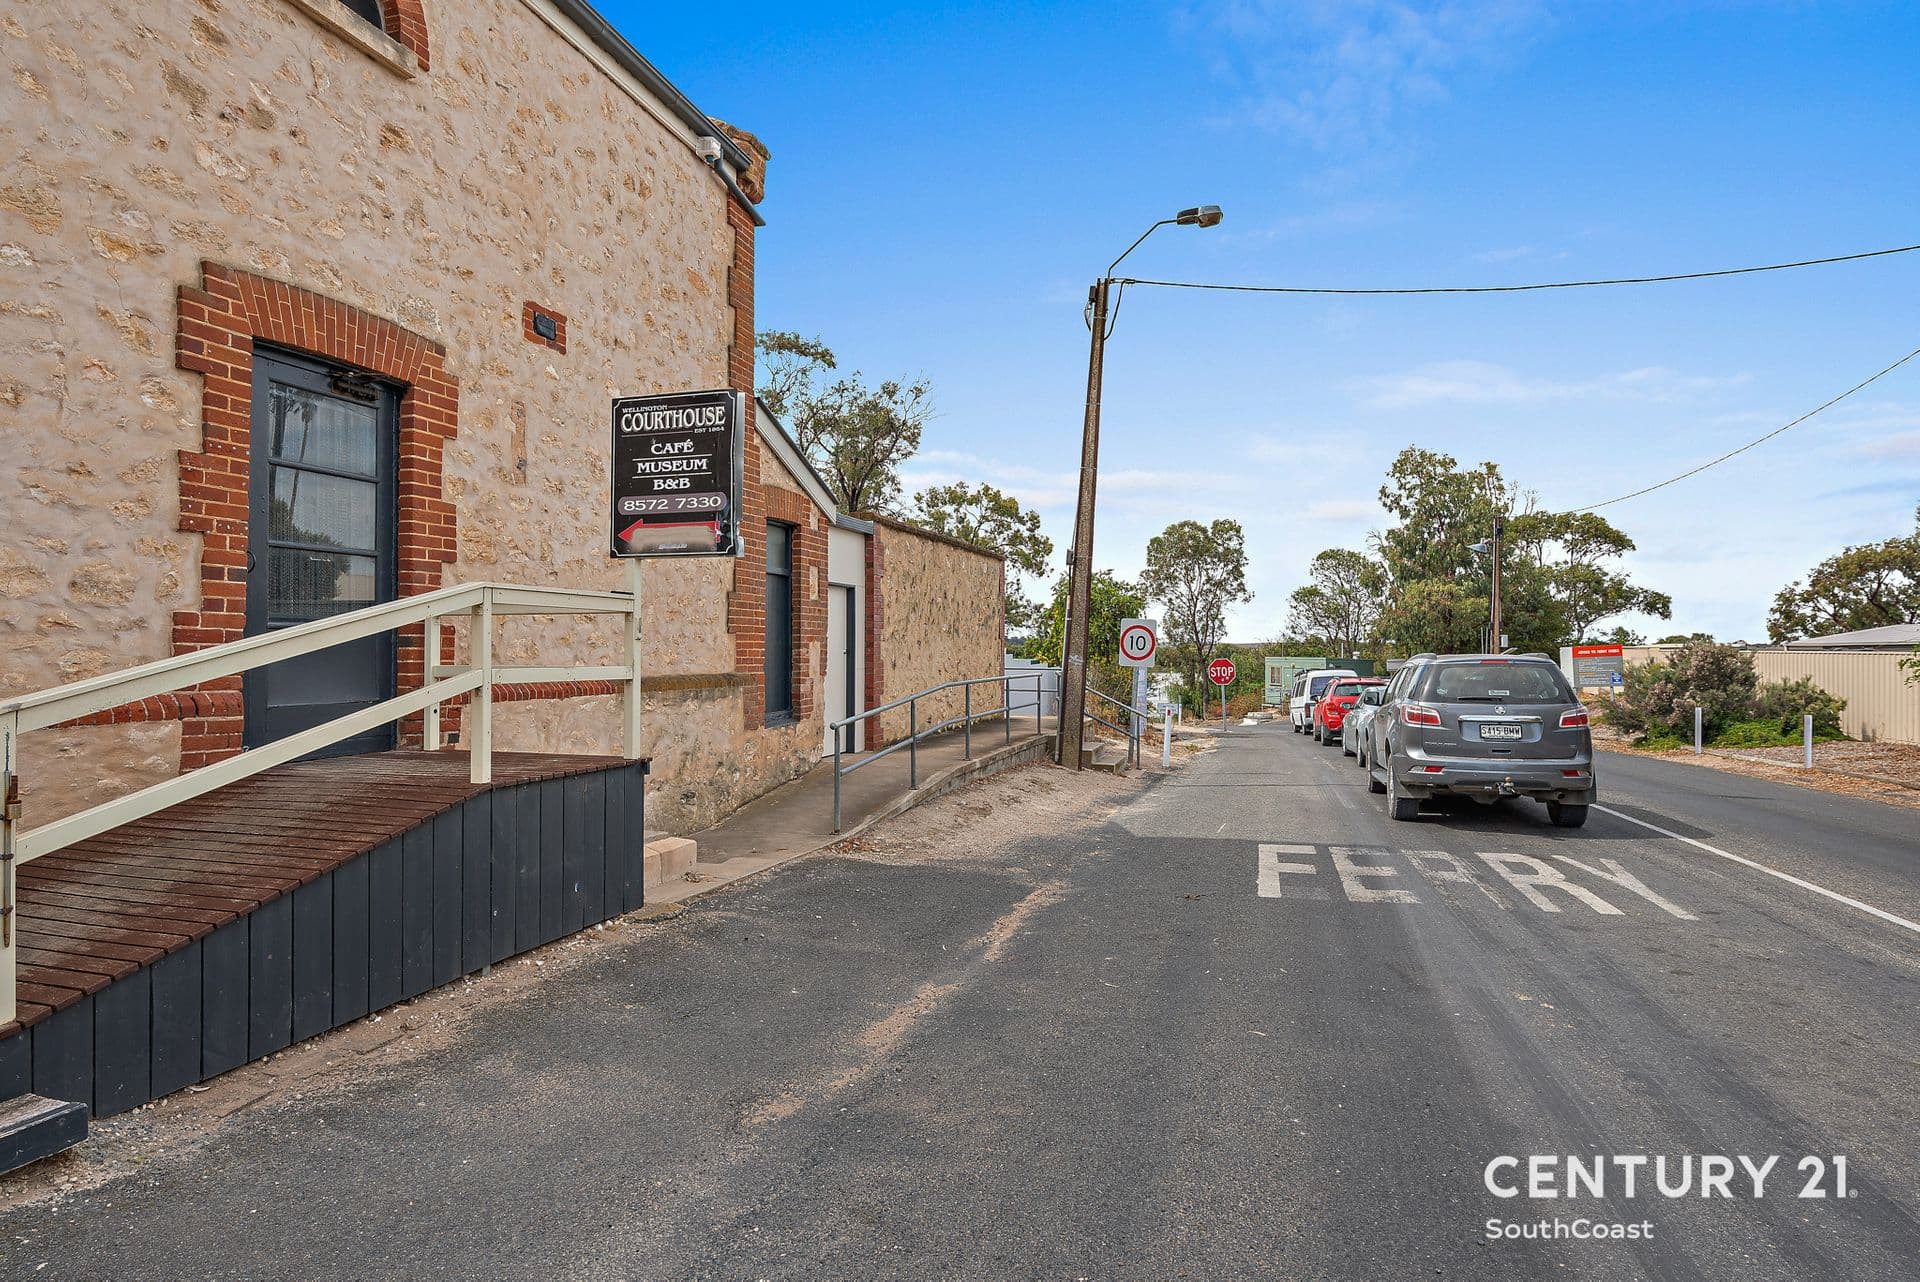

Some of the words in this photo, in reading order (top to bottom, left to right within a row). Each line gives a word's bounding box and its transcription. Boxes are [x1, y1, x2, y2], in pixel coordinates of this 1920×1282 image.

[622, 404, 668, 414] WELLINGTON
[621, 406, 727, 433] COURTHOUSE
[650, 438, 695, 455] CAFÉ
[636, 458, 708, 474] MUSEUM
[652, 477, 691, 491] B&B
[623, 499, 669, 512] 8572
[676, 496, 722, 509] 7330
[1129, 635, 1147, 651] 10
[1210, 666, 1234, 678] STOP
[1481, 726, 1501, 735] S415
[1257, 843, 1700, 921] FERRY
